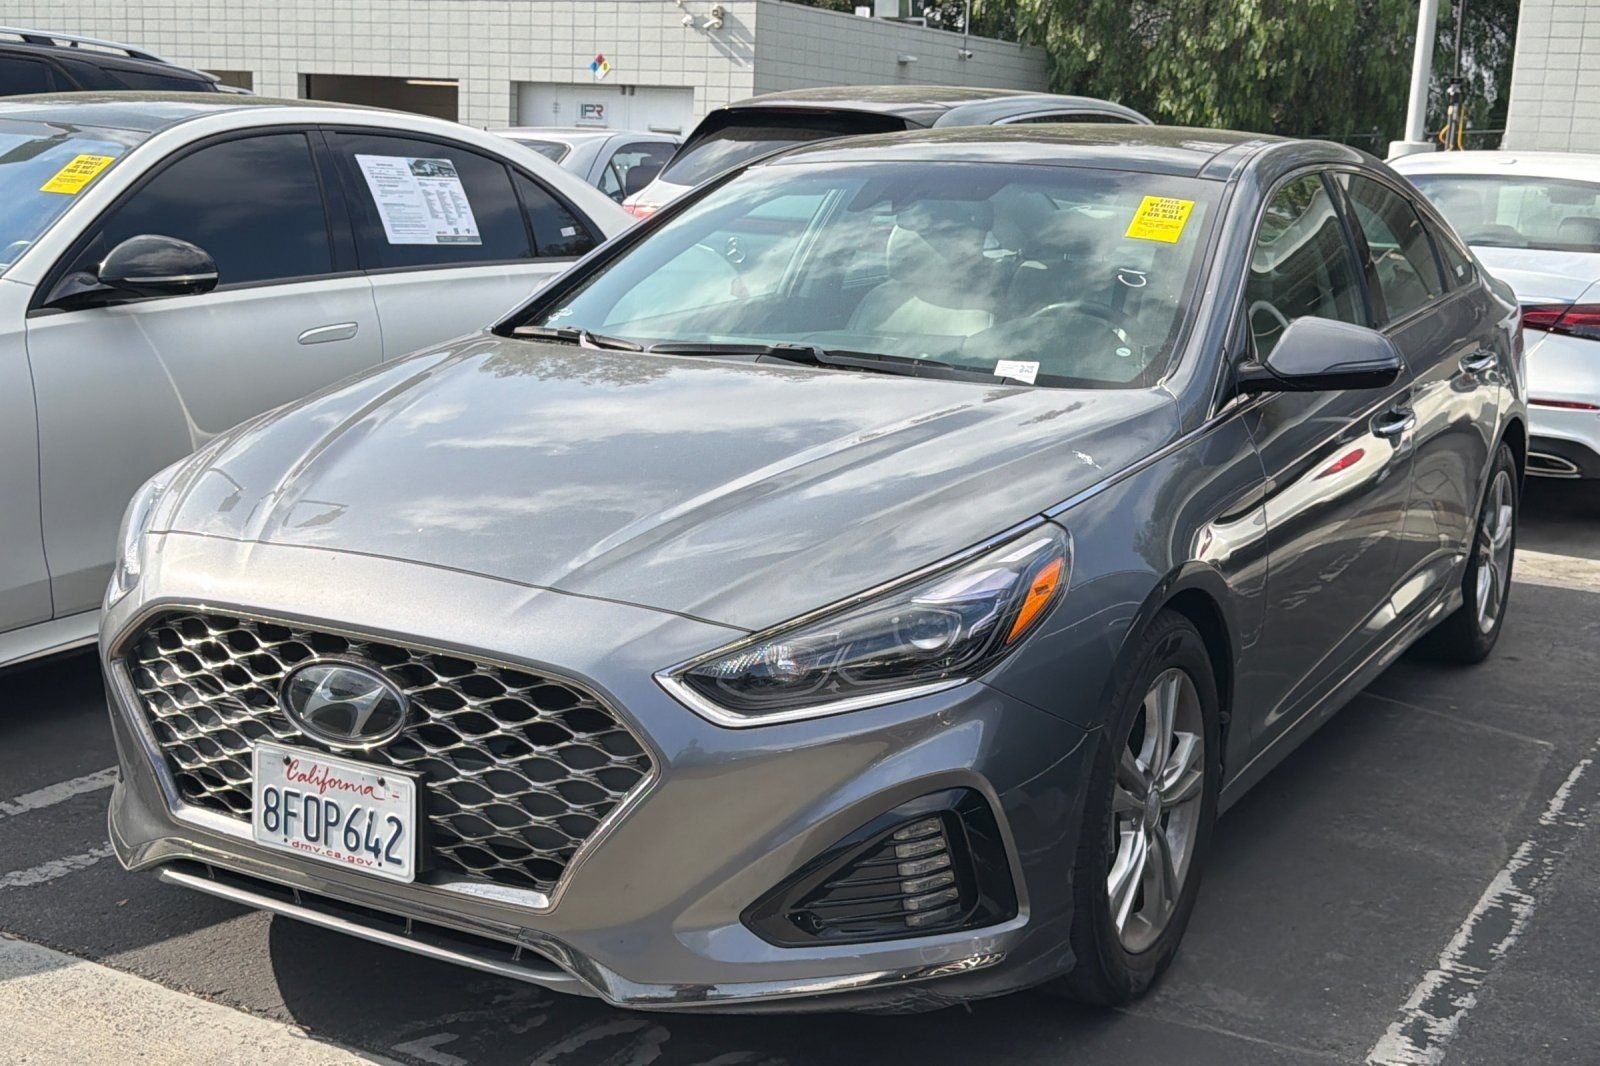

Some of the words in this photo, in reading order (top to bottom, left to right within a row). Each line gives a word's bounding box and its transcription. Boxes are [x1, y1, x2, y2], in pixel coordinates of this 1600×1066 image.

[580, 103, 604, 116] IPR
[1149, 202, 1185, 210] VEHICLE
[286, 758, 385, 801] California
[291, 841, 374, 867] dmv.ca.gov
